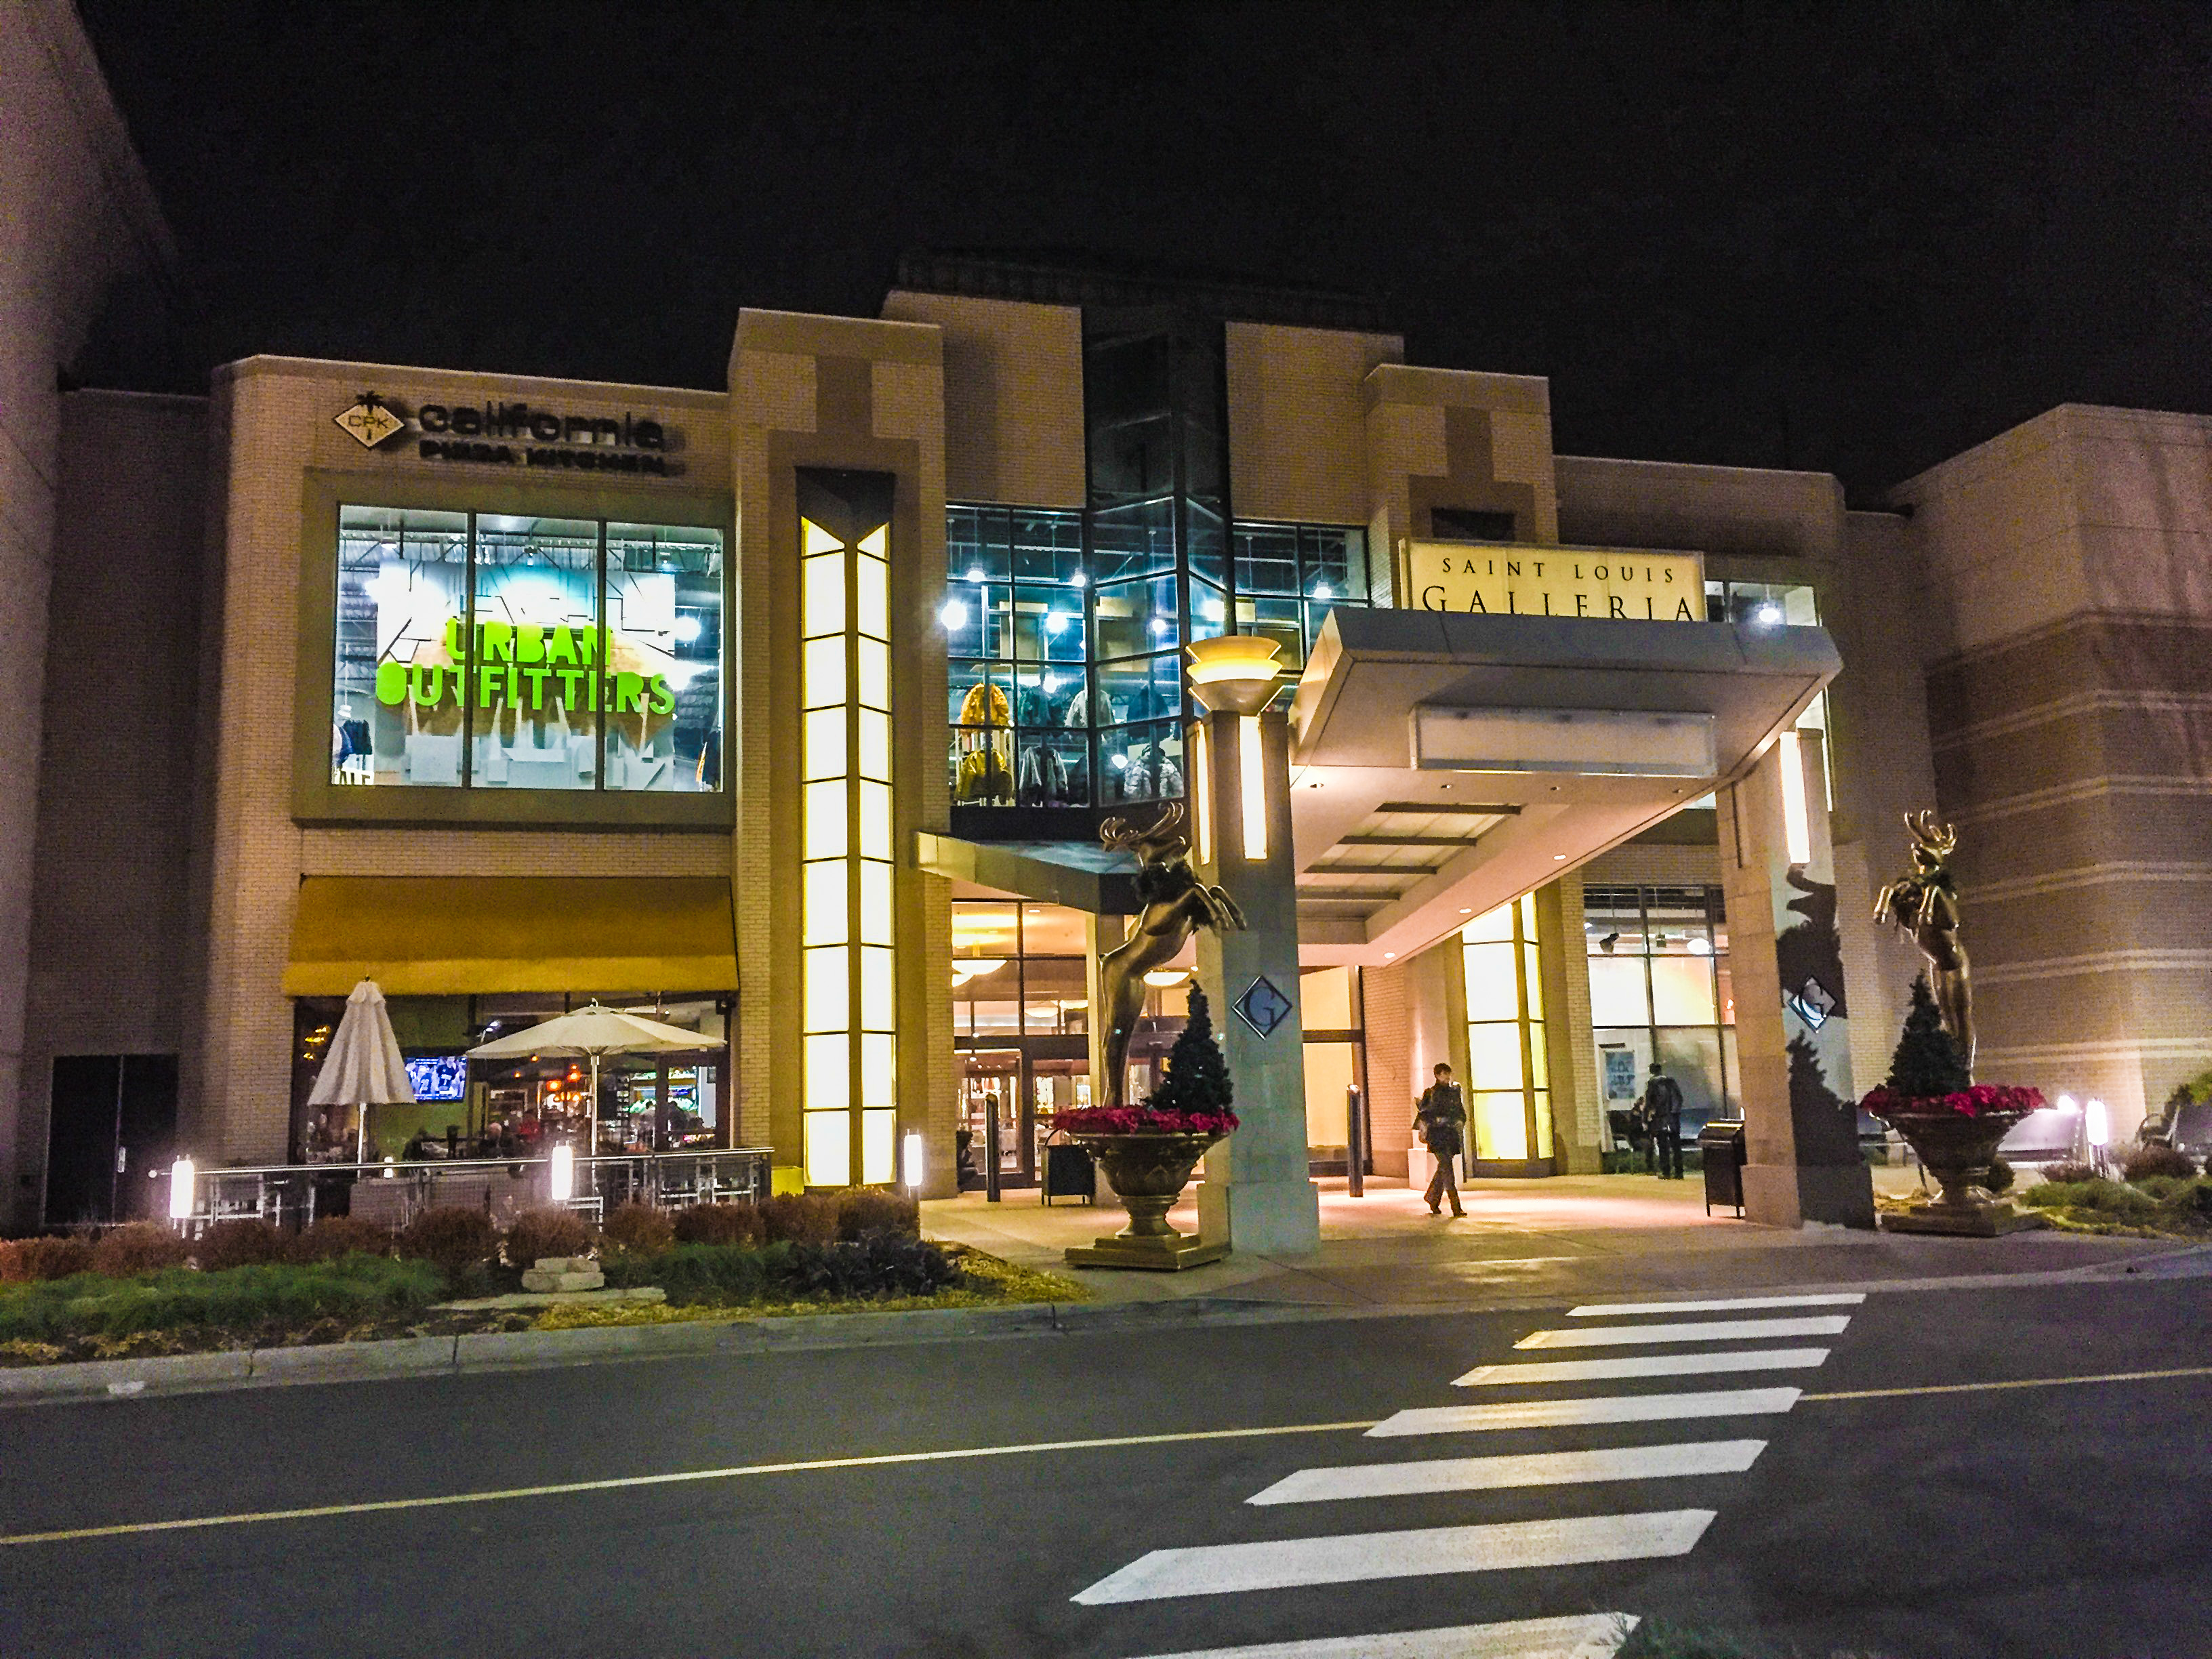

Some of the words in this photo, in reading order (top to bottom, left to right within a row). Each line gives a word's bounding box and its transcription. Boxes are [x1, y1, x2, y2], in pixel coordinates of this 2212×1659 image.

[348, 415, 389, 429] CPK
[1442, 558, 1545, 577] SAINT
[1574, 564, 1673, 583] LOUIS
[1422, 586, 1694, 621] GALLERIA
[446, 617, 611, 665] URBAN
[375, 661, 676, 715] OUTFITTERS
[1244, 986, 1275, 1027] G
